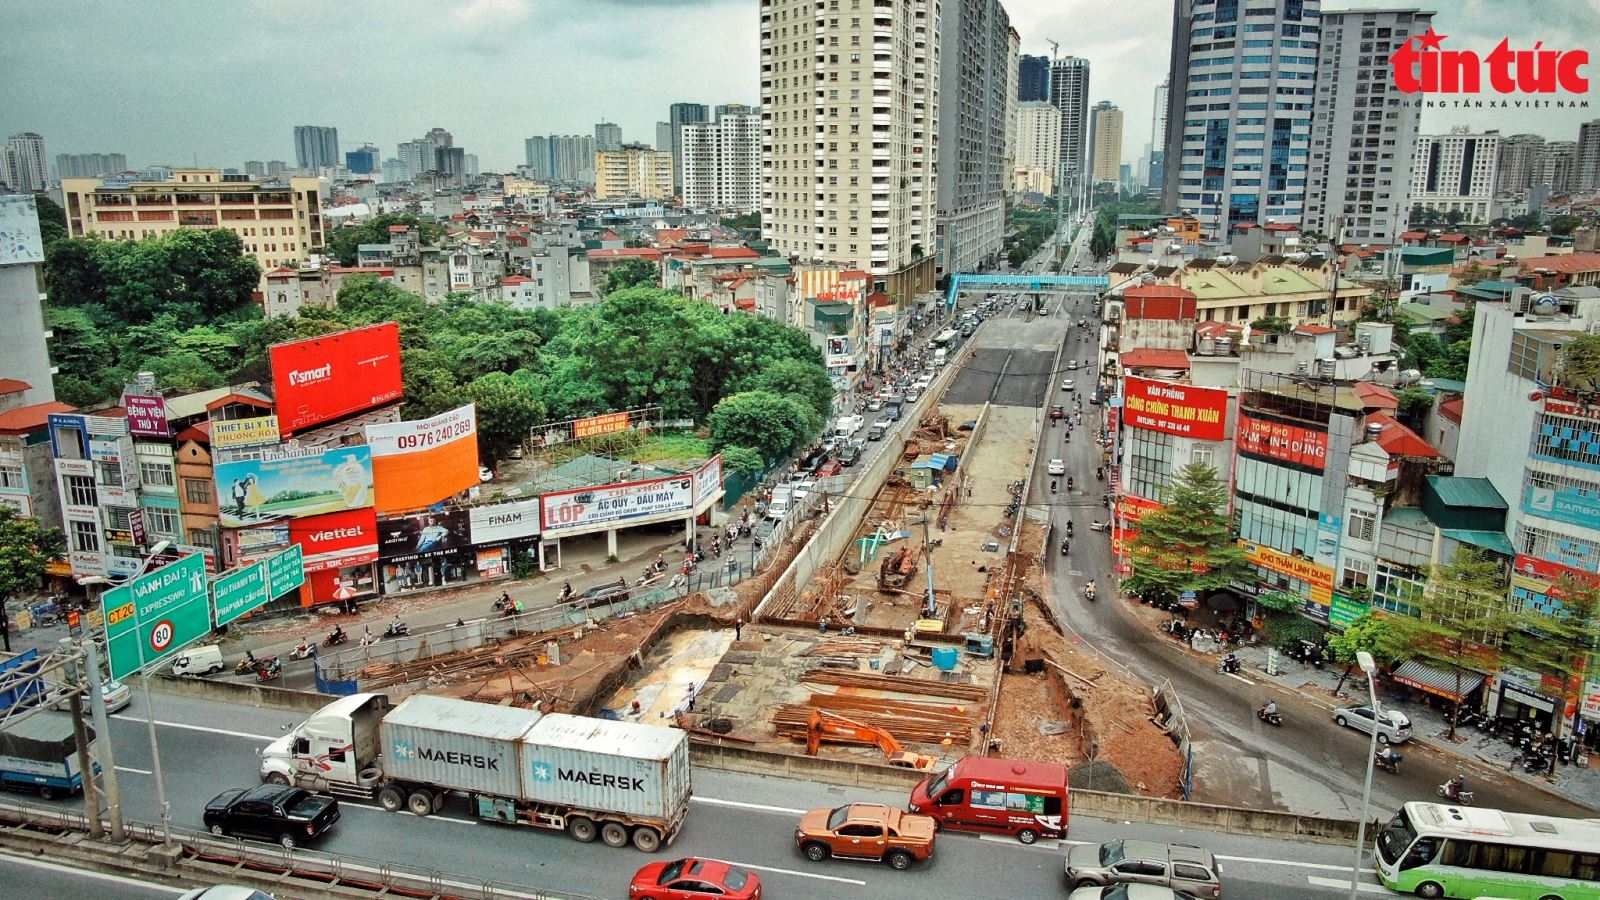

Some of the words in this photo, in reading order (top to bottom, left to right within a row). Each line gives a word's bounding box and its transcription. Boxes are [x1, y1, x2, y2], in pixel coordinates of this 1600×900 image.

[1147, 385, 1160, 397] VĂN
[1161, 389, 1185, 401] PHÒNG
[127, 404, 146, 418] BỆNH
[147, 406, 164, 419] VIỆN
[1126, 394, 1144, 410] CÔNG
[1145, 399, 1169, 416] CHỨNG
[1171, 404, 1196, 420] THANH
[1196, 407, 1220, 423] XUÂN
[137, 418, 151, 429] THÚ
[153, 420, 158, 430] Y
[255, 420, 262, 429] Y
[1272, 426, 1288, 437] KHO
[398, 431, 433, 449] 0976
[436, 425, 453, 443] 240
[454, 419, 471, 436] 269
[262, 446, 326, 462] Enchanteur
[612, 497, 629, 509] QUY
[656, 490, 675, 502] MÁY
[488, 512, 522, 526] FINAM
[309, 525, 363, 542] viettel
[284, 548, 298, 561] GIAO
[1260, 552, 1274, 562] KHO
[1275, 555, 1293, 569] THẢM
[1294, 563, 1310, 575] LINH
[135, 578, 162, 598] VÀNH
[163, 570, 180, 587] ĐAI
[181, 566, 188, 578] 3
[228, 576, 248, 592] THANH
[140, 589, 186, 616] EXPRESSWAY
[155, 627, 169, 643] 80
[418, 747, 499, 771] MAERSK
[558, 767, 645, 792] MAERSK
